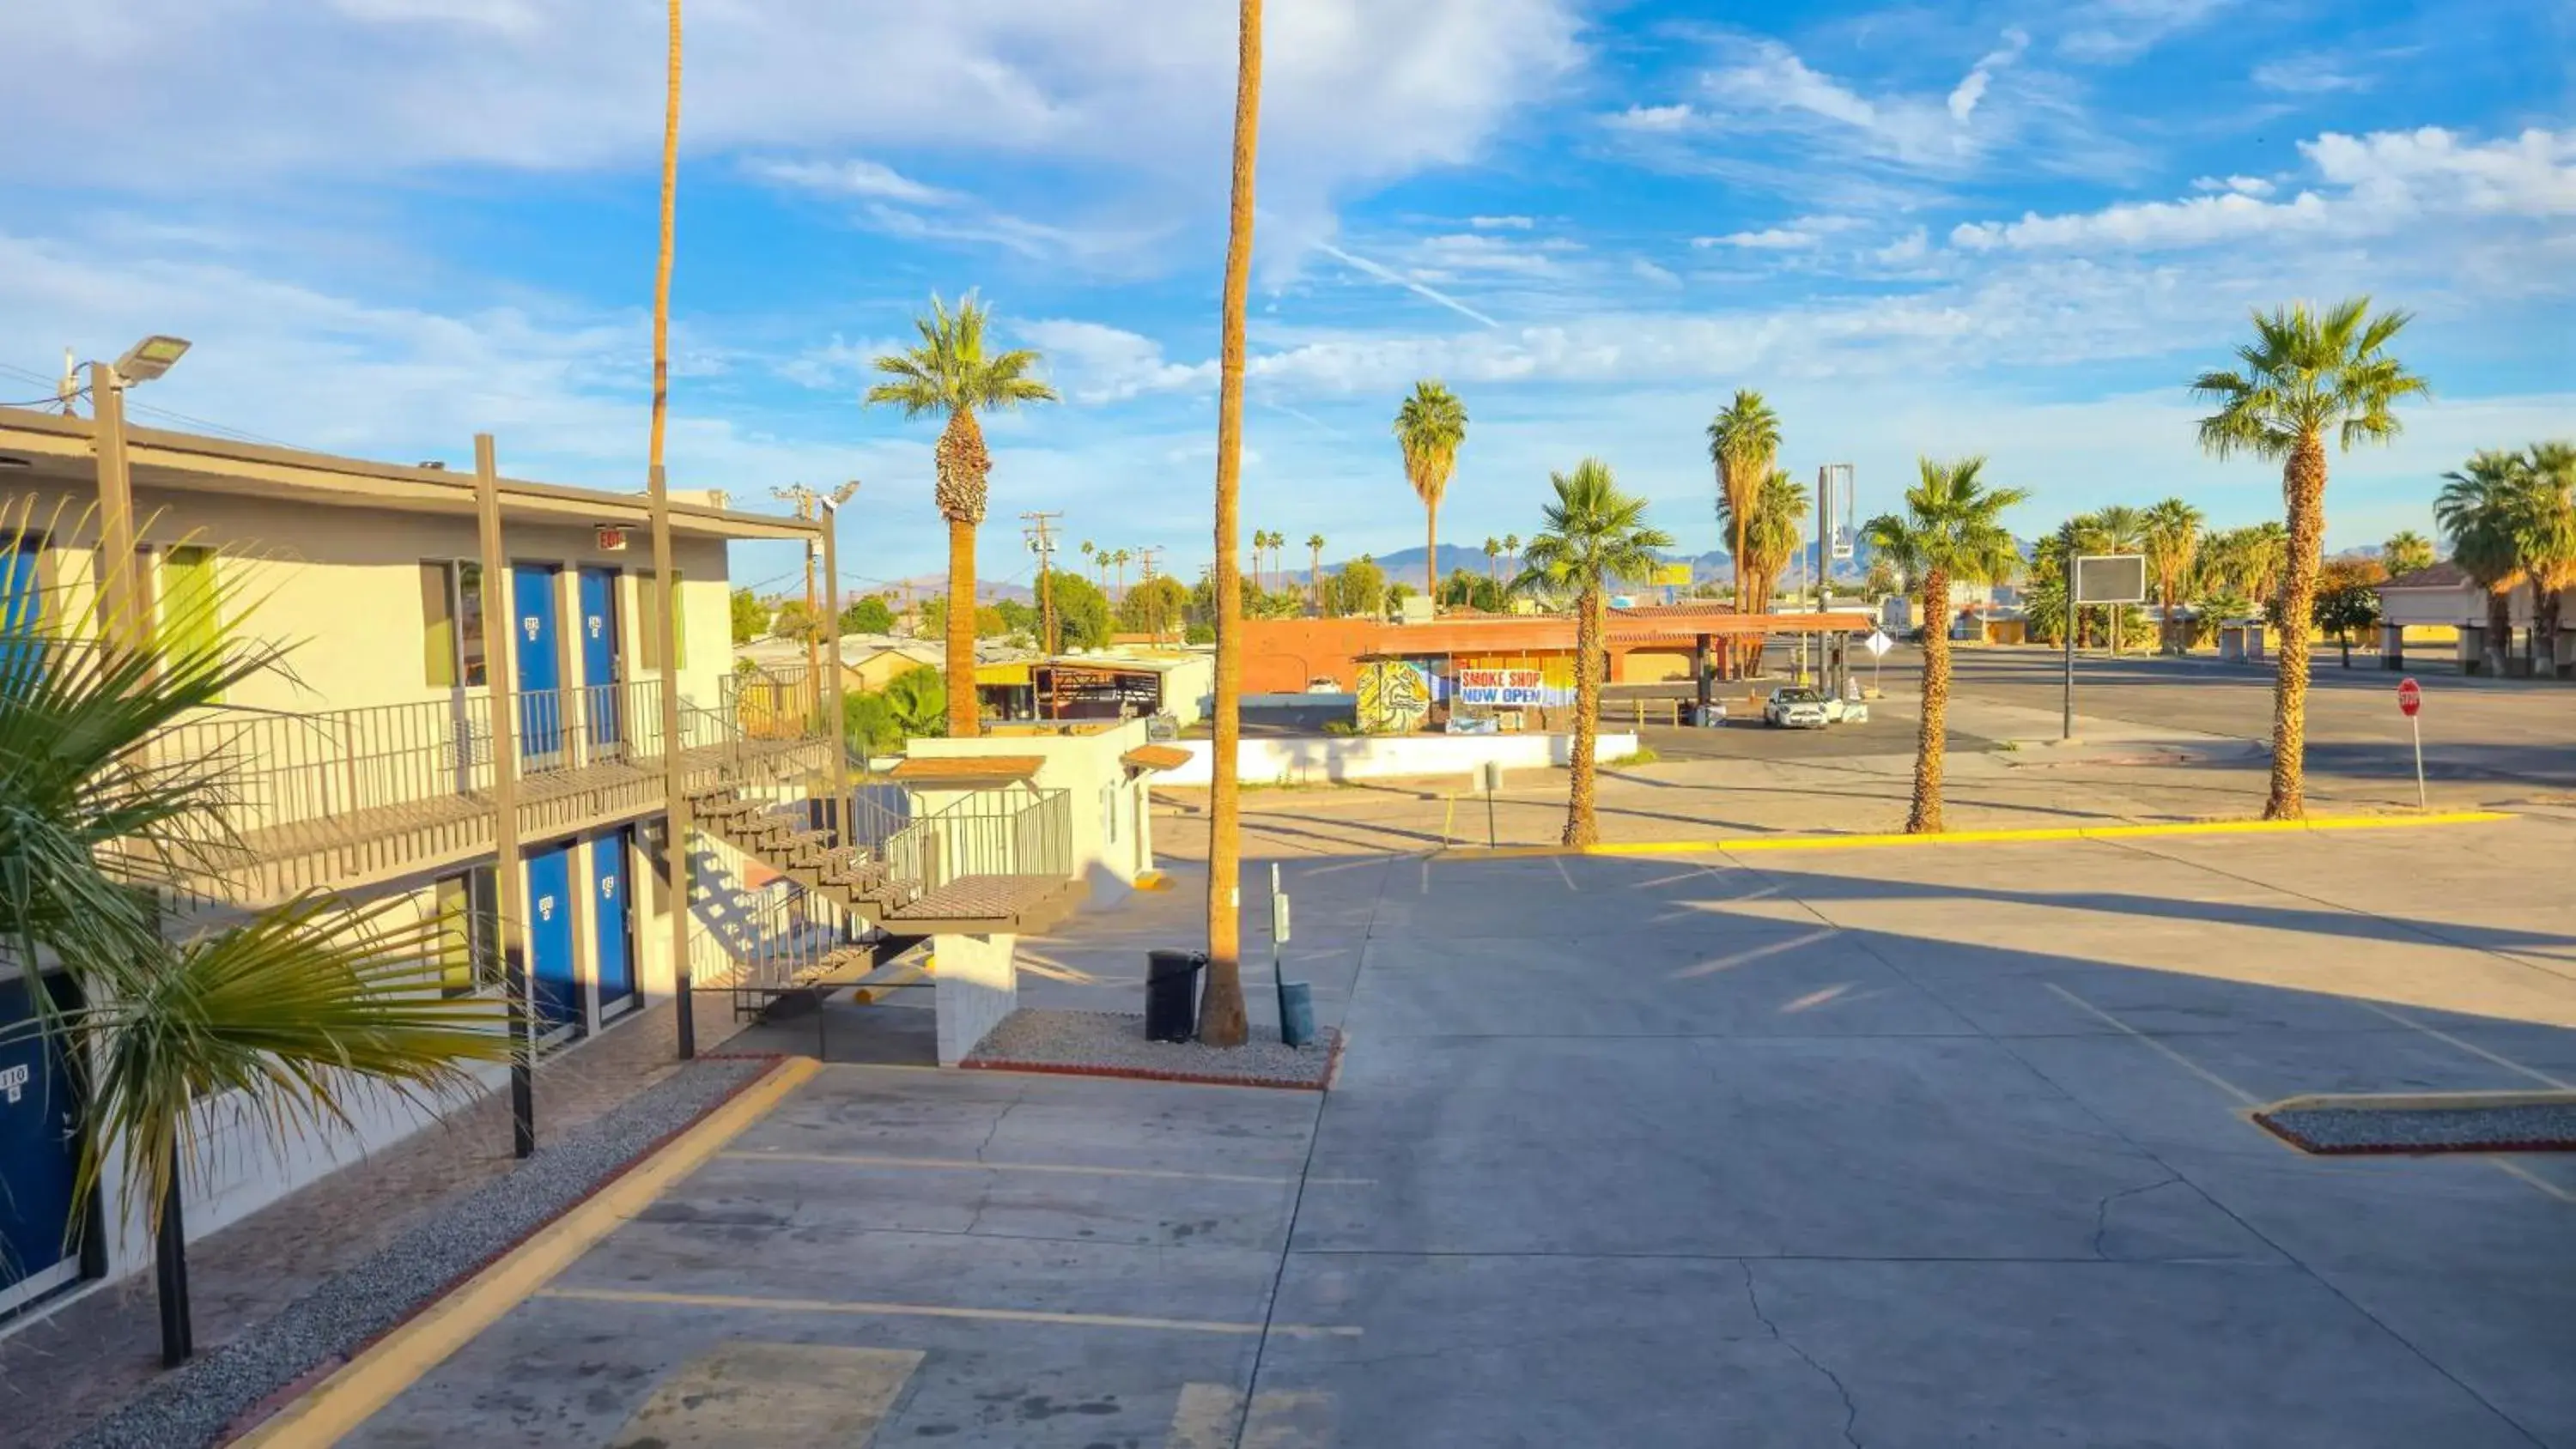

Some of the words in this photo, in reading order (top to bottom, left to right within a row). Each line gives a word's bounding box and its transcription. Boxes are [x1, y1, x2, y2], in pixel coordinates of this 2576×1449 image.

[600, 531, 625, 549] EXIT
[1462, 671, 1504, 687] SMOKE
[1509, 671, 1540, 688] SHOP
[1462, 688, 1498, 703] NOW
[1503, 688, 1540, 703] OPEN
[2400, 691, 2420, 705] STOP
[2, 1067, 26, 1087] 110
